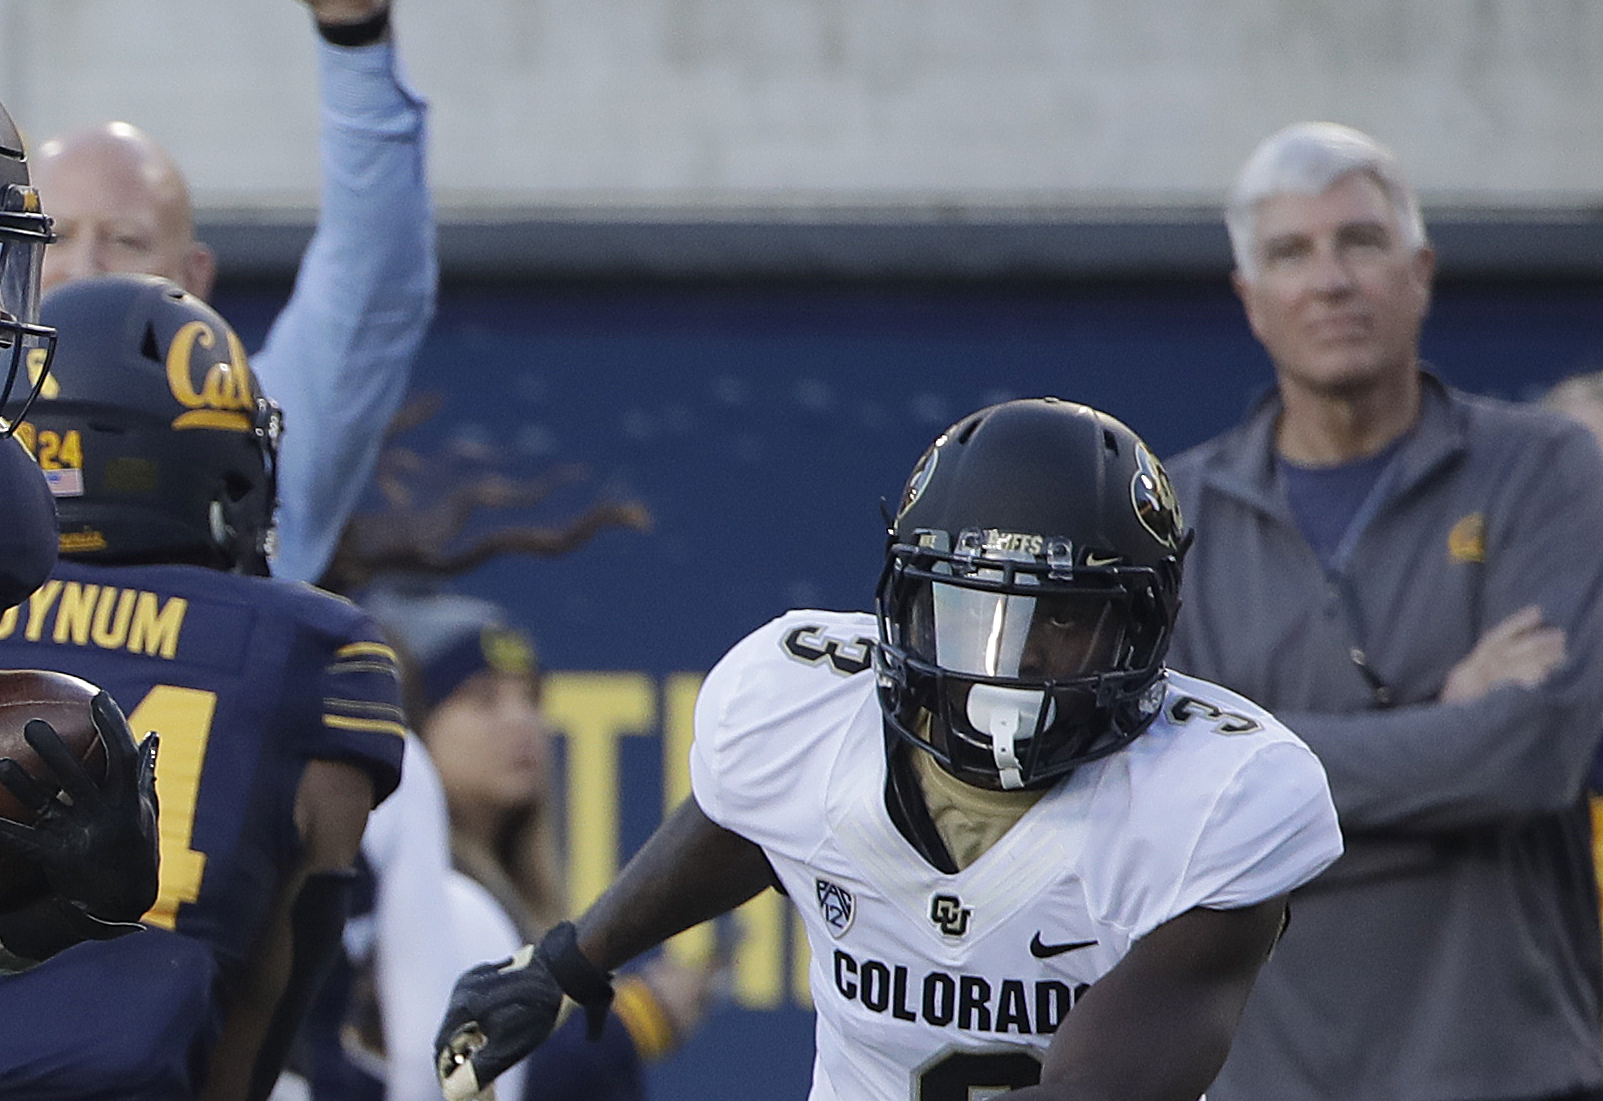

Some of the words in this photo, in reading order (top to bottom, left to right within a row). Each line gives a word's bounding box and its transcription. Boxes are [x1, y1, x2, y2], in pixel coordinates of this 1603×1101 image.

[165, 320, 260, 432] Cal
[38, 430, 84, 470] 24
[777, 621, 878, 679] 3
[1163, 694, 1265, 736] 3
[126, 683, 219, 932] 4
[816, 877, 853, 921] PAC
[825, 902, 845, 930] 12
[929, 892, 973, 937] CU
[832, 947, 1091, 1035] COLORAD
